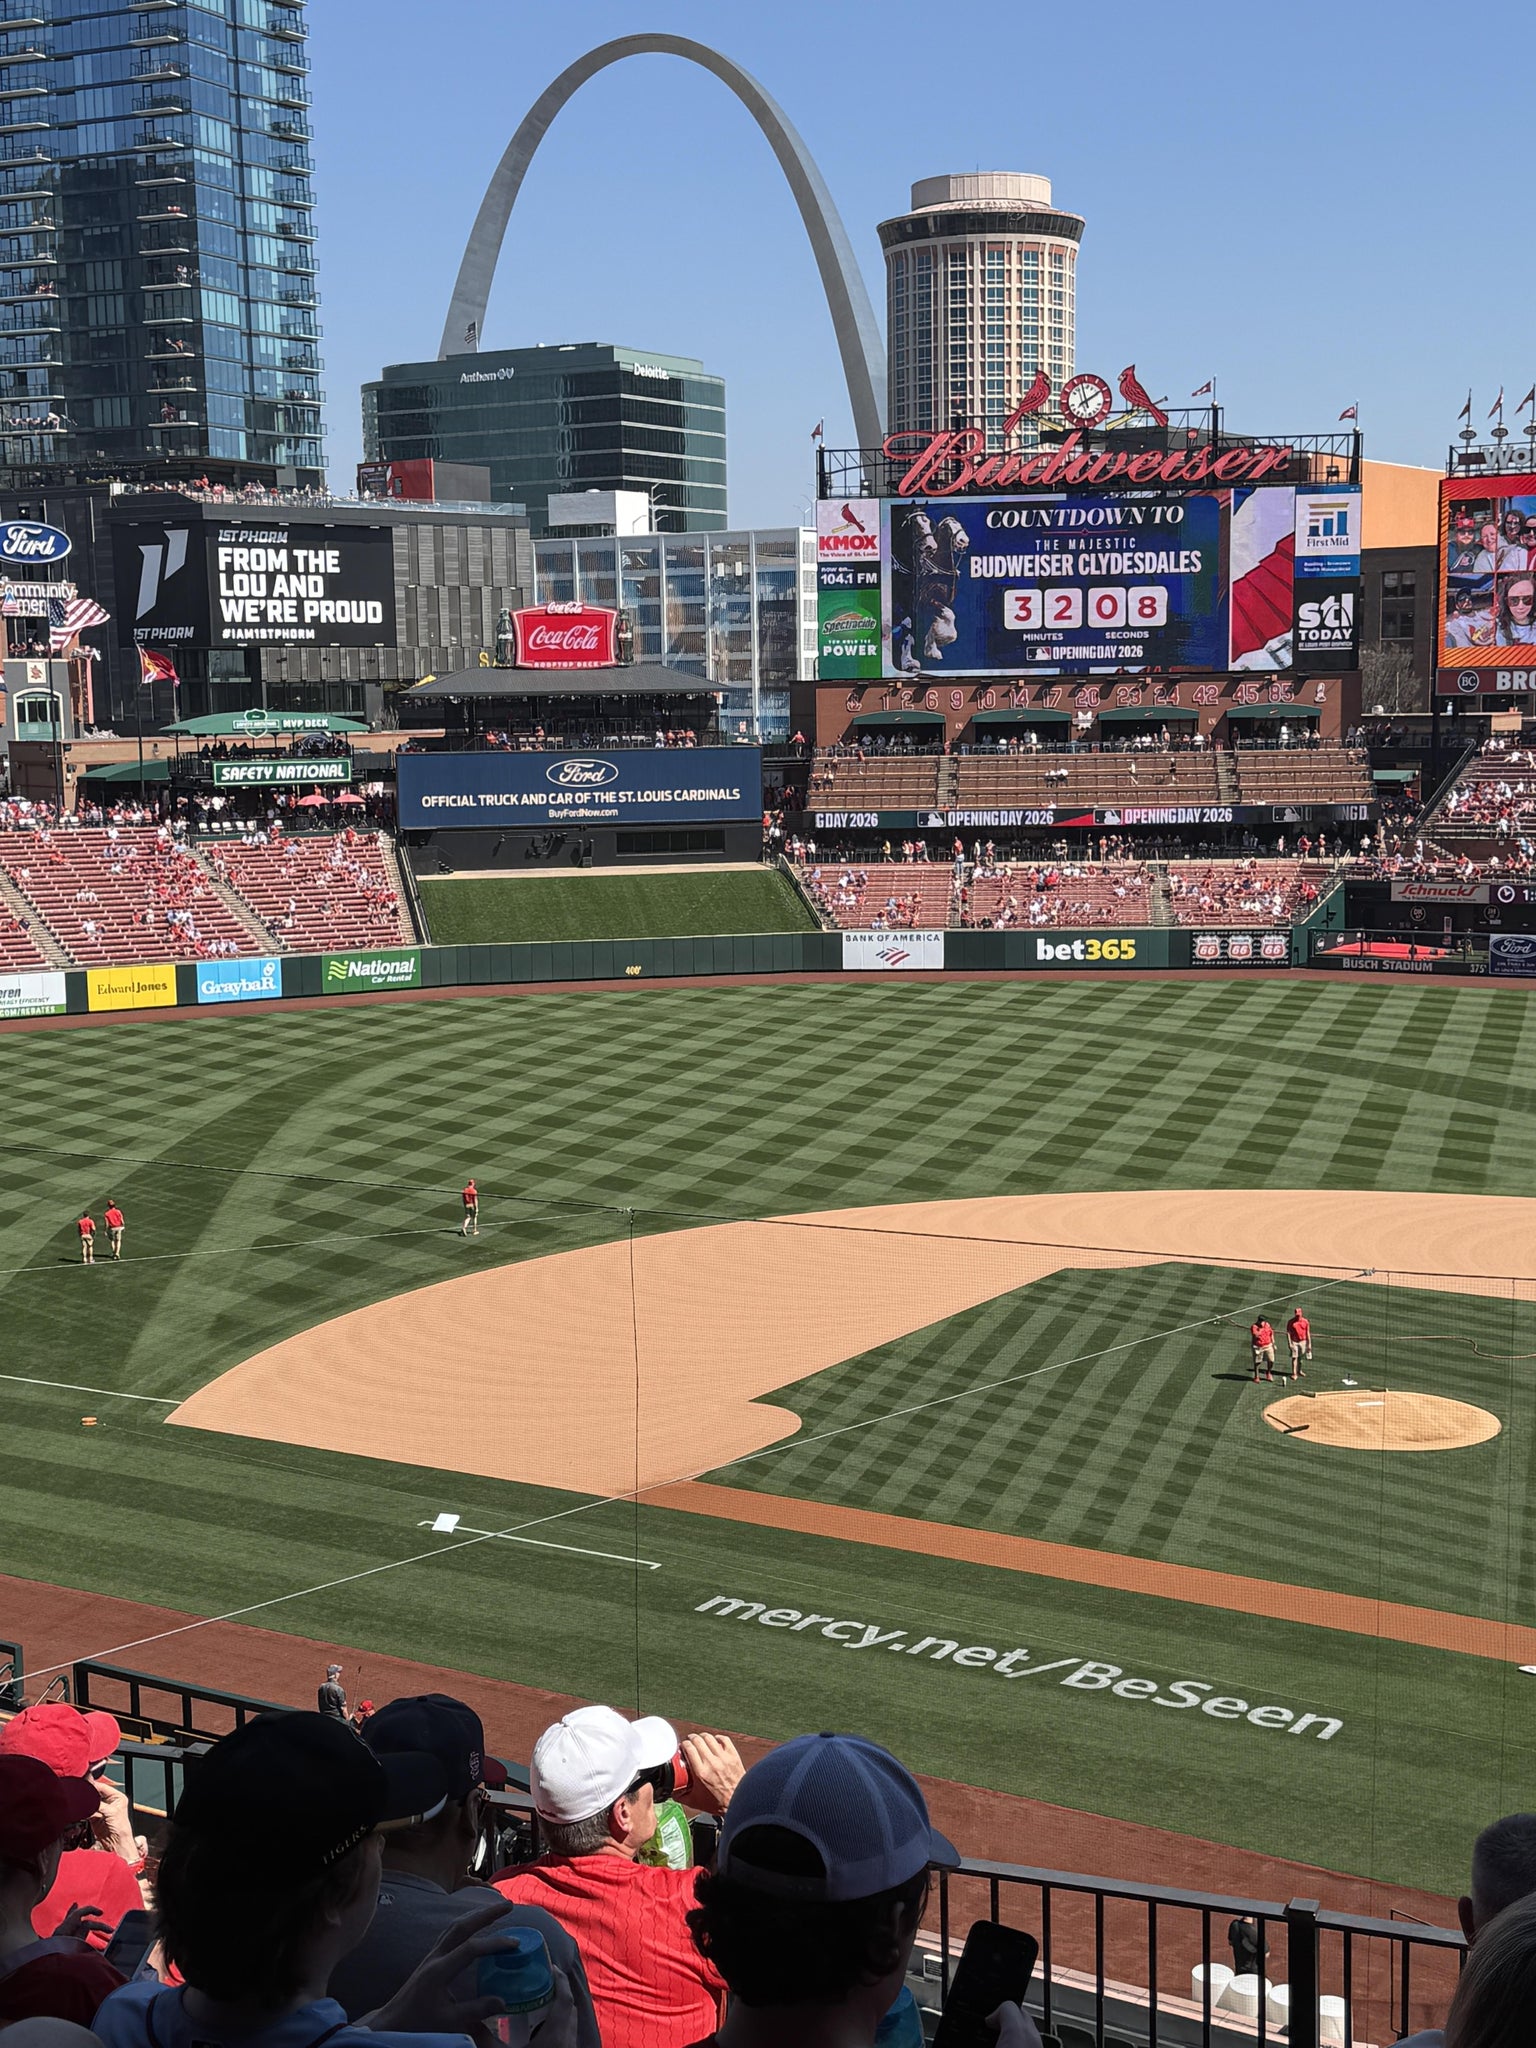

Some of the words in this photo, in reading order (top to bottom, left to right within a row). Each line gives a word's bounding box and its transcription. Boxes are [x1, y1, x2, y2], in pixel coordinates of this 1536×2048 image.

[460, 372, 496, 384] Anthem
[883, 428, 1293, 496] Budweiser
[986, 507, 1146, 529] COUNTDOWN
[1150, 506, 1184, 524] TO
[3, 526, 55, 556] Ford
[218, 529, 238, 542] 1ST
[239, 530, 288, 543] PHORM
[819, 535, 878, 551] KMOX
[1307, 538, 1329, 548] First
[1330, 537, 1350, 547] Mid
[1035, 540, 1060, 551] THE
[1069, 538, 1137, 550] MAJESTIC
[218, 547, 288, 573] FROM
[293, 549, 340, 574] THE
[970, 554, 1074, 578] BUDWEISER
[1078, 551, 1202, 576] CLYDESDALES
[219, 573, 267, 598] LOU
[272, 574, 324, 598] AND
[820, 573, 853, 585] 104.1
[857, 572, 878, 584] FM
[219, 599, 298, 623] WE'RE
[304, 600, 383, 624] PROUD
[547, 601, 583, 614] Coca-Cola
[1298, 593, 1354, 629] stl
[133, 628, 151, 640] 1ST
[151, 626, 194, 640] PHORM
[822, 617, 877, 635] Spectracide
[222, 628, 315, 640] #IAM1STPHORM
[529, 625, 603, 650] Coca-Cola
[1023, 633, 1064, 641] MINUTES
[1105, 631, 1150, 640] SECONDS
[1298, 629, 1353, 640] TODAY
[823, 645, 877, 656] POWER
[1052, 646, 1098, 660] OPENING
[1098, 646, 1117, 659] DAY
[1118, 645, 1144, 659] 2026
[1462, 676, 1476, 686] BC
[902, 690, 915, 710] 2
[925, 690, 939, 710] 6
[950, 690, 964, 710] 9
[976, 690, 997, 710] 10
[1009, 689, 1030, 709] 14
[1042, 688, 1063, 708] 17
[1075, 687, 1100, 707] 20
[1117, 686, 1142, 706] 23
[1154, 686, 1180, 706] 24
[1192, 685, 1219, 705] 42
[1233, 684, 1259, 704] 45
[1269, 683, 1295, 702] 85
[283, 719, 304, 729] MVP
[305, 719, 329, 729] DECK
[221, 766, 273, 780] SAFETY
[276, 763, 345, 779] NATIONAL
[559, 763, 606, 784] Ford
[421, 795, 477, 807] OFFICIAL
[478, 794, 518, 806] TRUCK
[521, 793, 547, 805] AND
[548, 792, 573, 805] CAR
[574, 792, 592, 804] OF
[592, 791, 617, 804] THE
[618, 791, 636, 803] ST.
[637, 790, 673, 802] LOUIS
[674, 788, 741, 801] CARDINALS
[548, 808, 618, 819] BuyFordNow.com
[825, 813, 848, 828] DAY
[850, 813, 879, 828] 2026
[948, 811, 999, 827] OPENING
[1000, 811, 1024, 826] DAY
[1025, 810, 1054, 825] 2026
[1124, 808, 1177, 825] OPENING
[1178, 808, 1202, 824] DAY
[1203, 808, 1233, 823] 2026
[1398, 884, 1480, 897] Schnucks
[892, 934, 941, 942] AMERICA
[1036, 938, 1137, 960] bet365
[1200, 945, 1216, 955] 66
[1232, 945, 1248, 955] 66
[1264, 945, 1281, 955] 66
[1500, 938, 1532, 954] Ford
[1342, 957, 1379, 970] BUSCH
[1382, 960, 1433, 972] STADIUM
[371, 976, 385, 984] Car
[386, 974, 412, 983] Rental
[97, 982, 135, 995] Edward
[136, 981, 168, 993] Jones
[695, 1594, 1345, 1741] mercy.net/BeSeen
[320, 1824, 369, 1865] TIGERS
